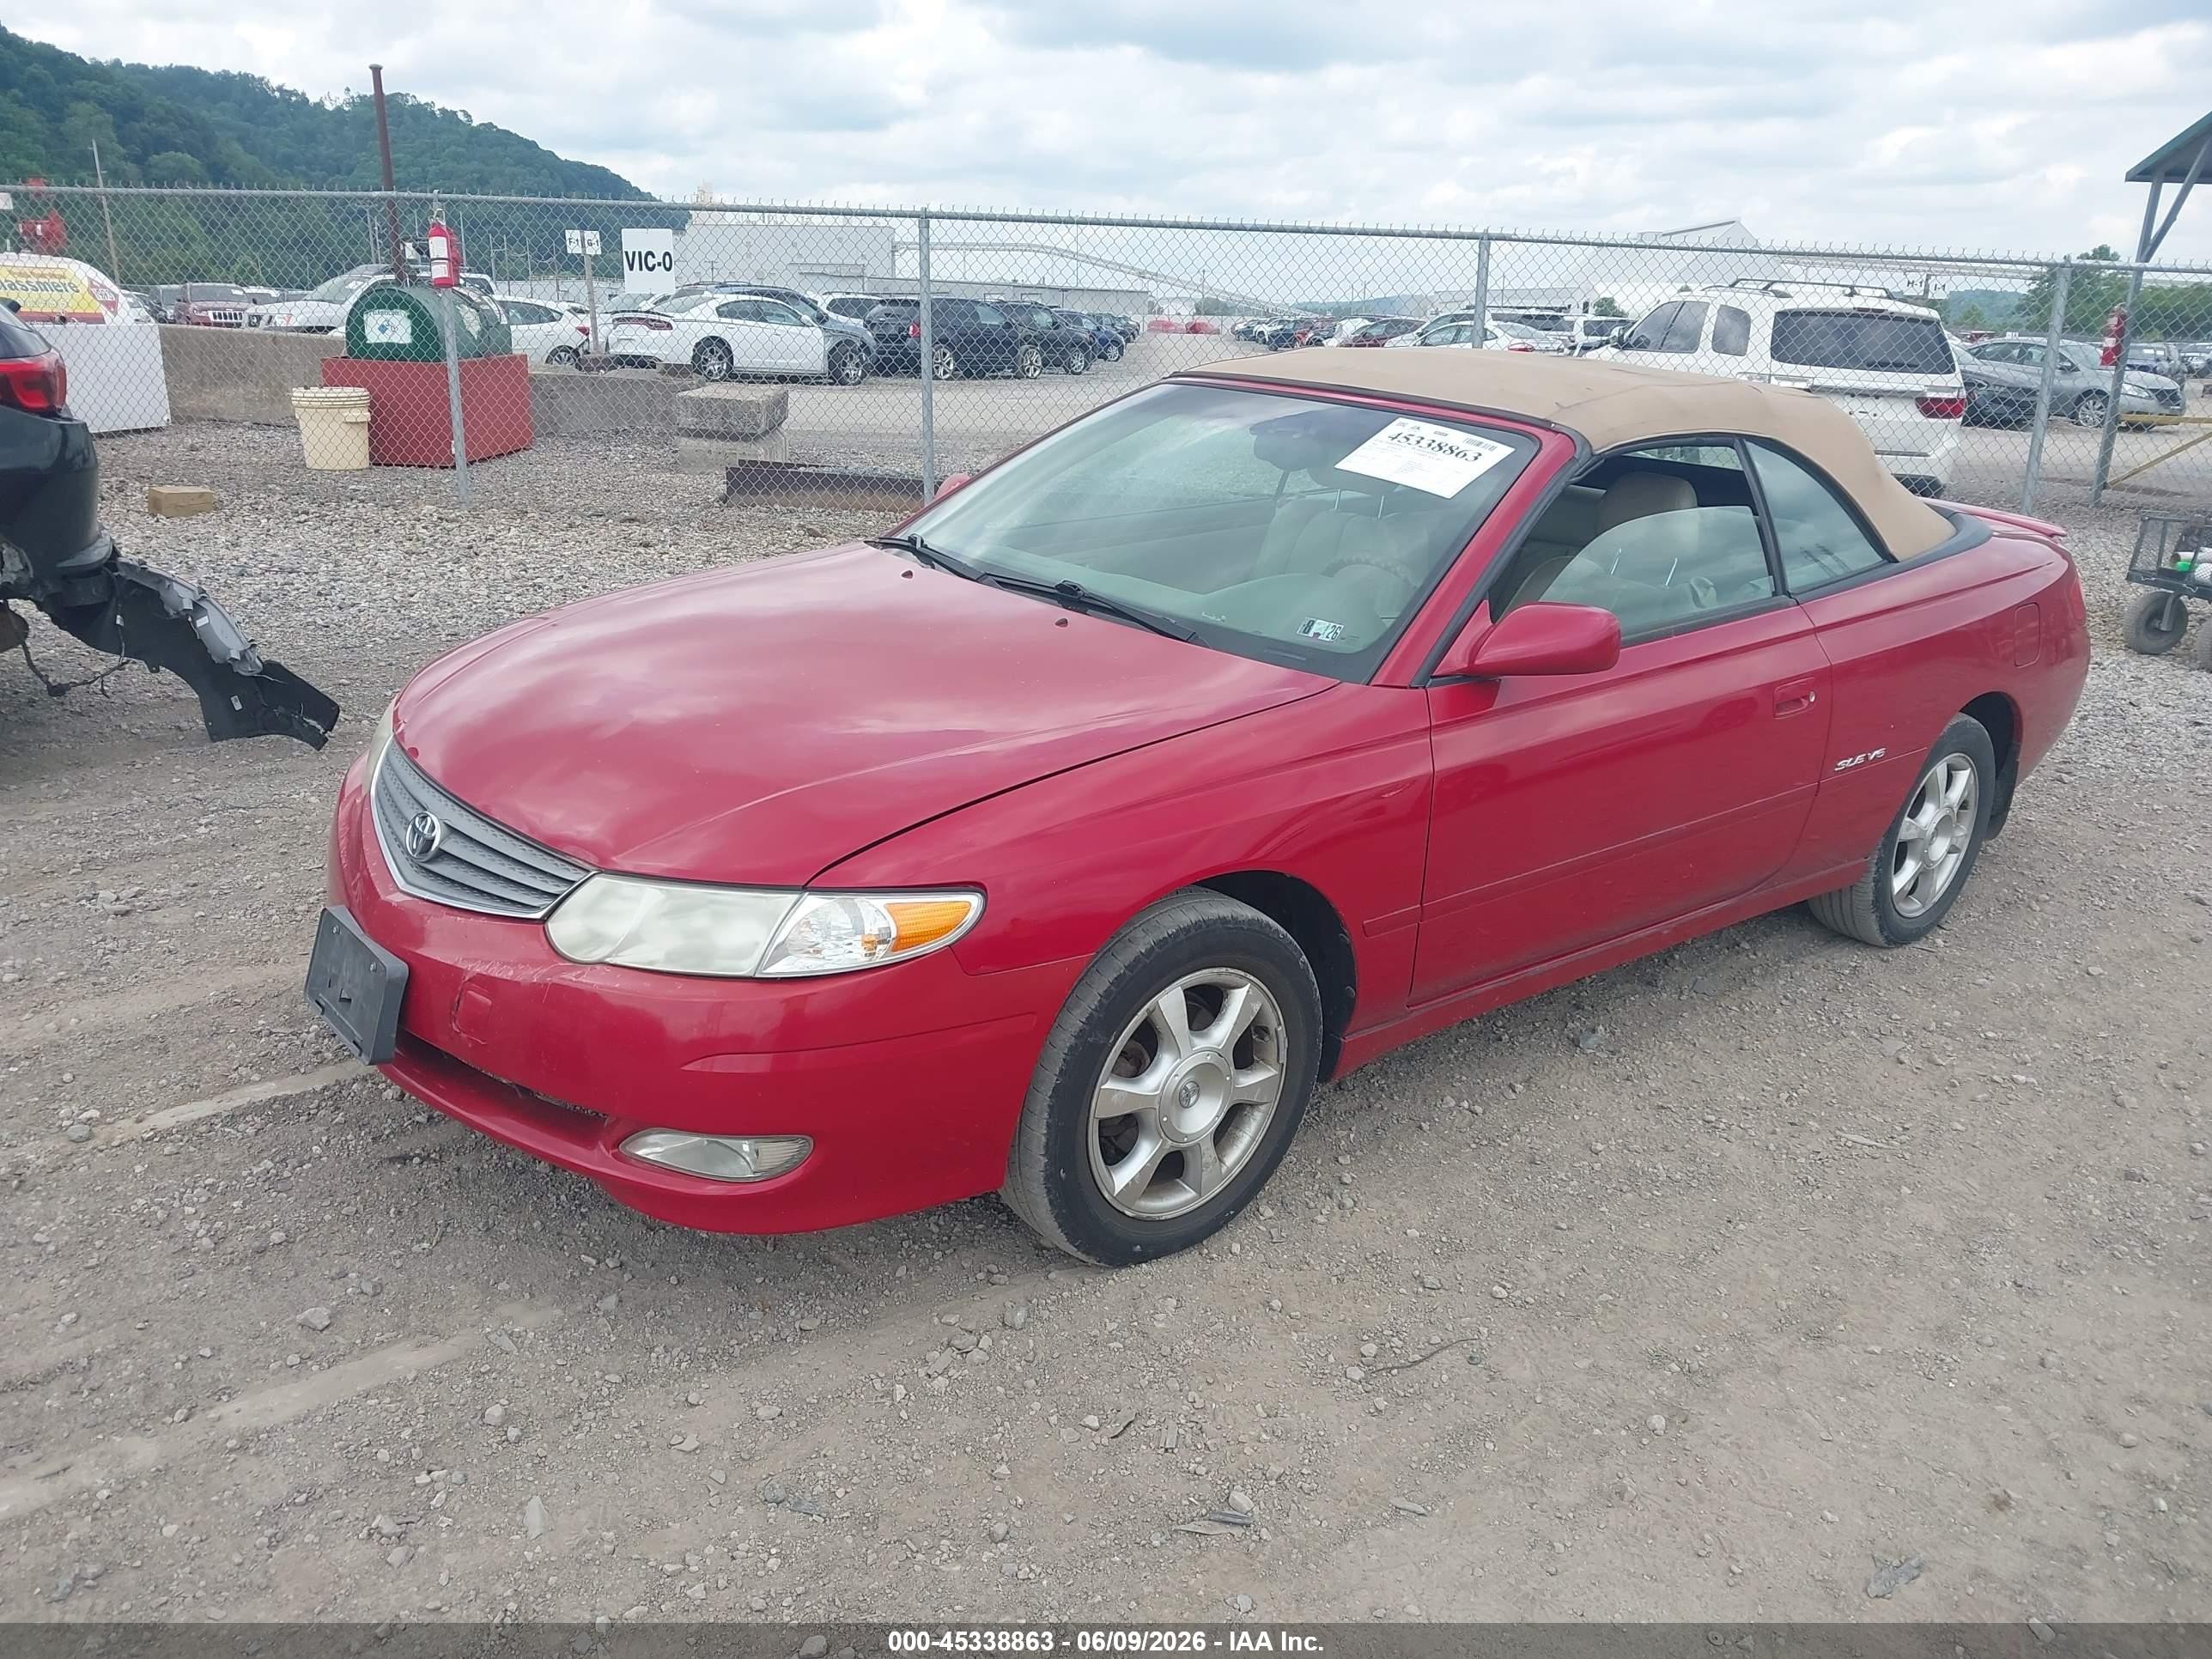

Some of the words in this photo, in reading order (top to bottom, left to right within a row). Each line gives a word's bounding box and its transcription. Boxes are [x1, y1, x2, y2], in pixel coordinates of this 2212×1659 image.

[568, 237, 580, 246] F-1
[586, 239, 599, 247] G-1
[0, 279, 80, 293] lassmere
[1388, 431, 1483, 463] 45338863
[1834, 754, 1867, 771] SLE
